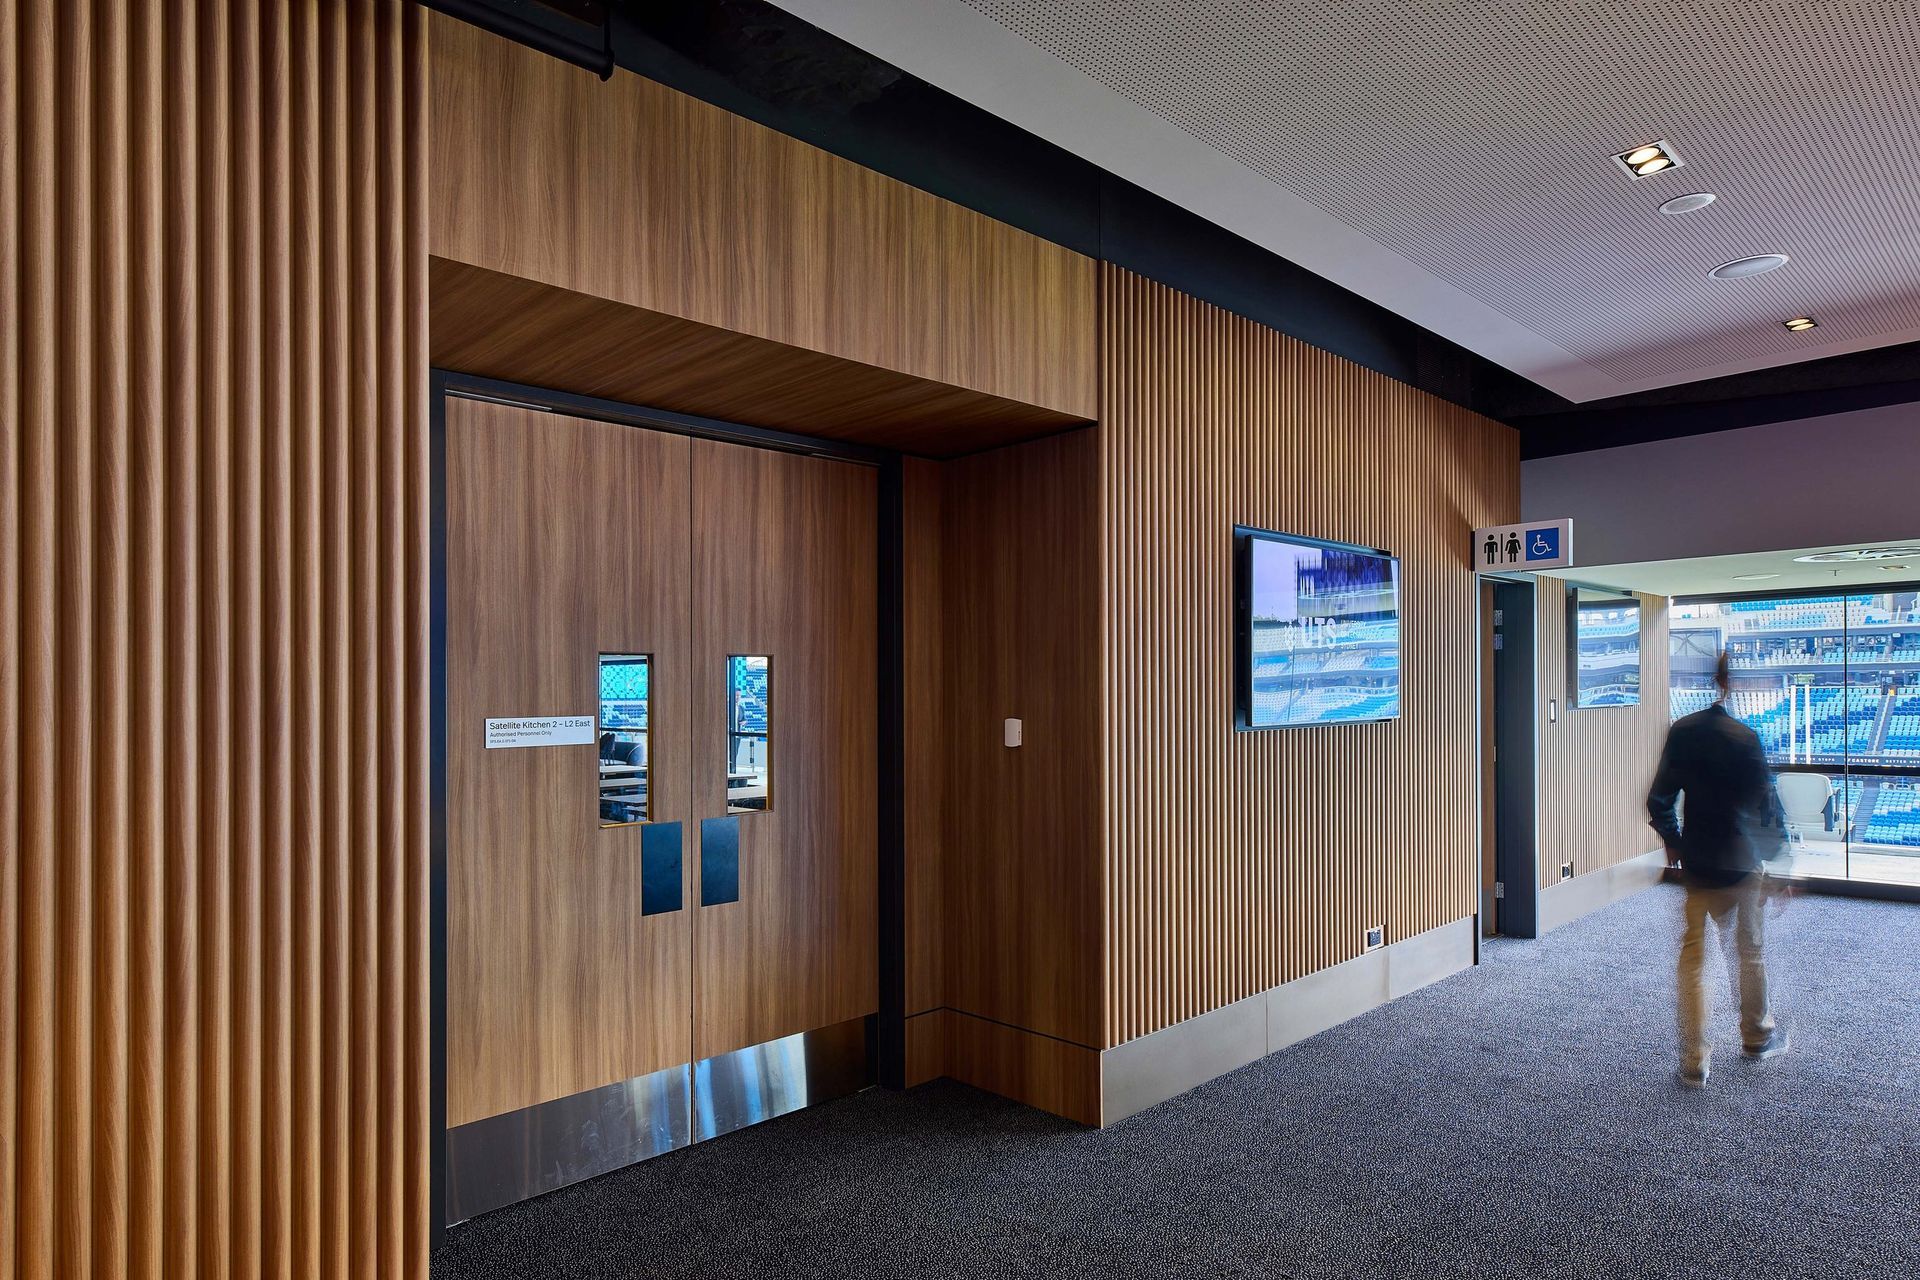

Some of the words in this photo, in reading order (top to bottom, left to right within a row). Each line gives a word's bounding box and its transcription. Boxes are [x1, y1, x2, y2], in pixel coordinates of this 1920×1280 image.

[489, 721, 521, 730] Satellite
[522, 720, 551, 729] Kitchen
[552, 720, 557, 728] 2
[564, 720, 573, 728] L2
[575, 719, 591, 728] East
